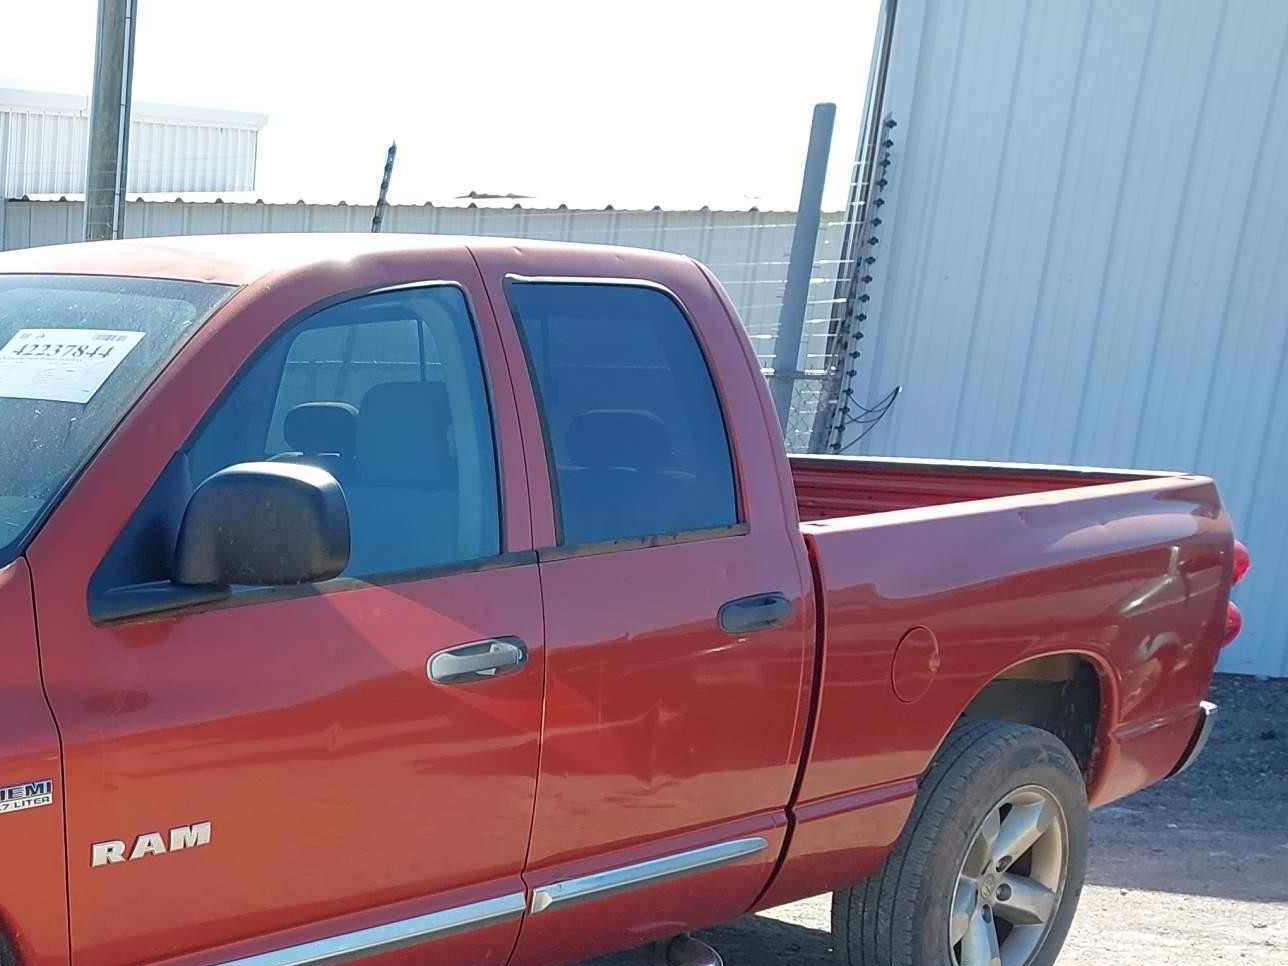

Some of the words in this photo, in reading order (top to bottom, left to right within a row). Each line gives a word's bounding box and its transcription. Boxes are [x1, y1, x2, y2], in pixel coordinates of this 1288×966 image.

[12, 343, 115, 358] 42237844
[14, 796, 50, 809] LITER
[91, 821, 211, 867] RAM
